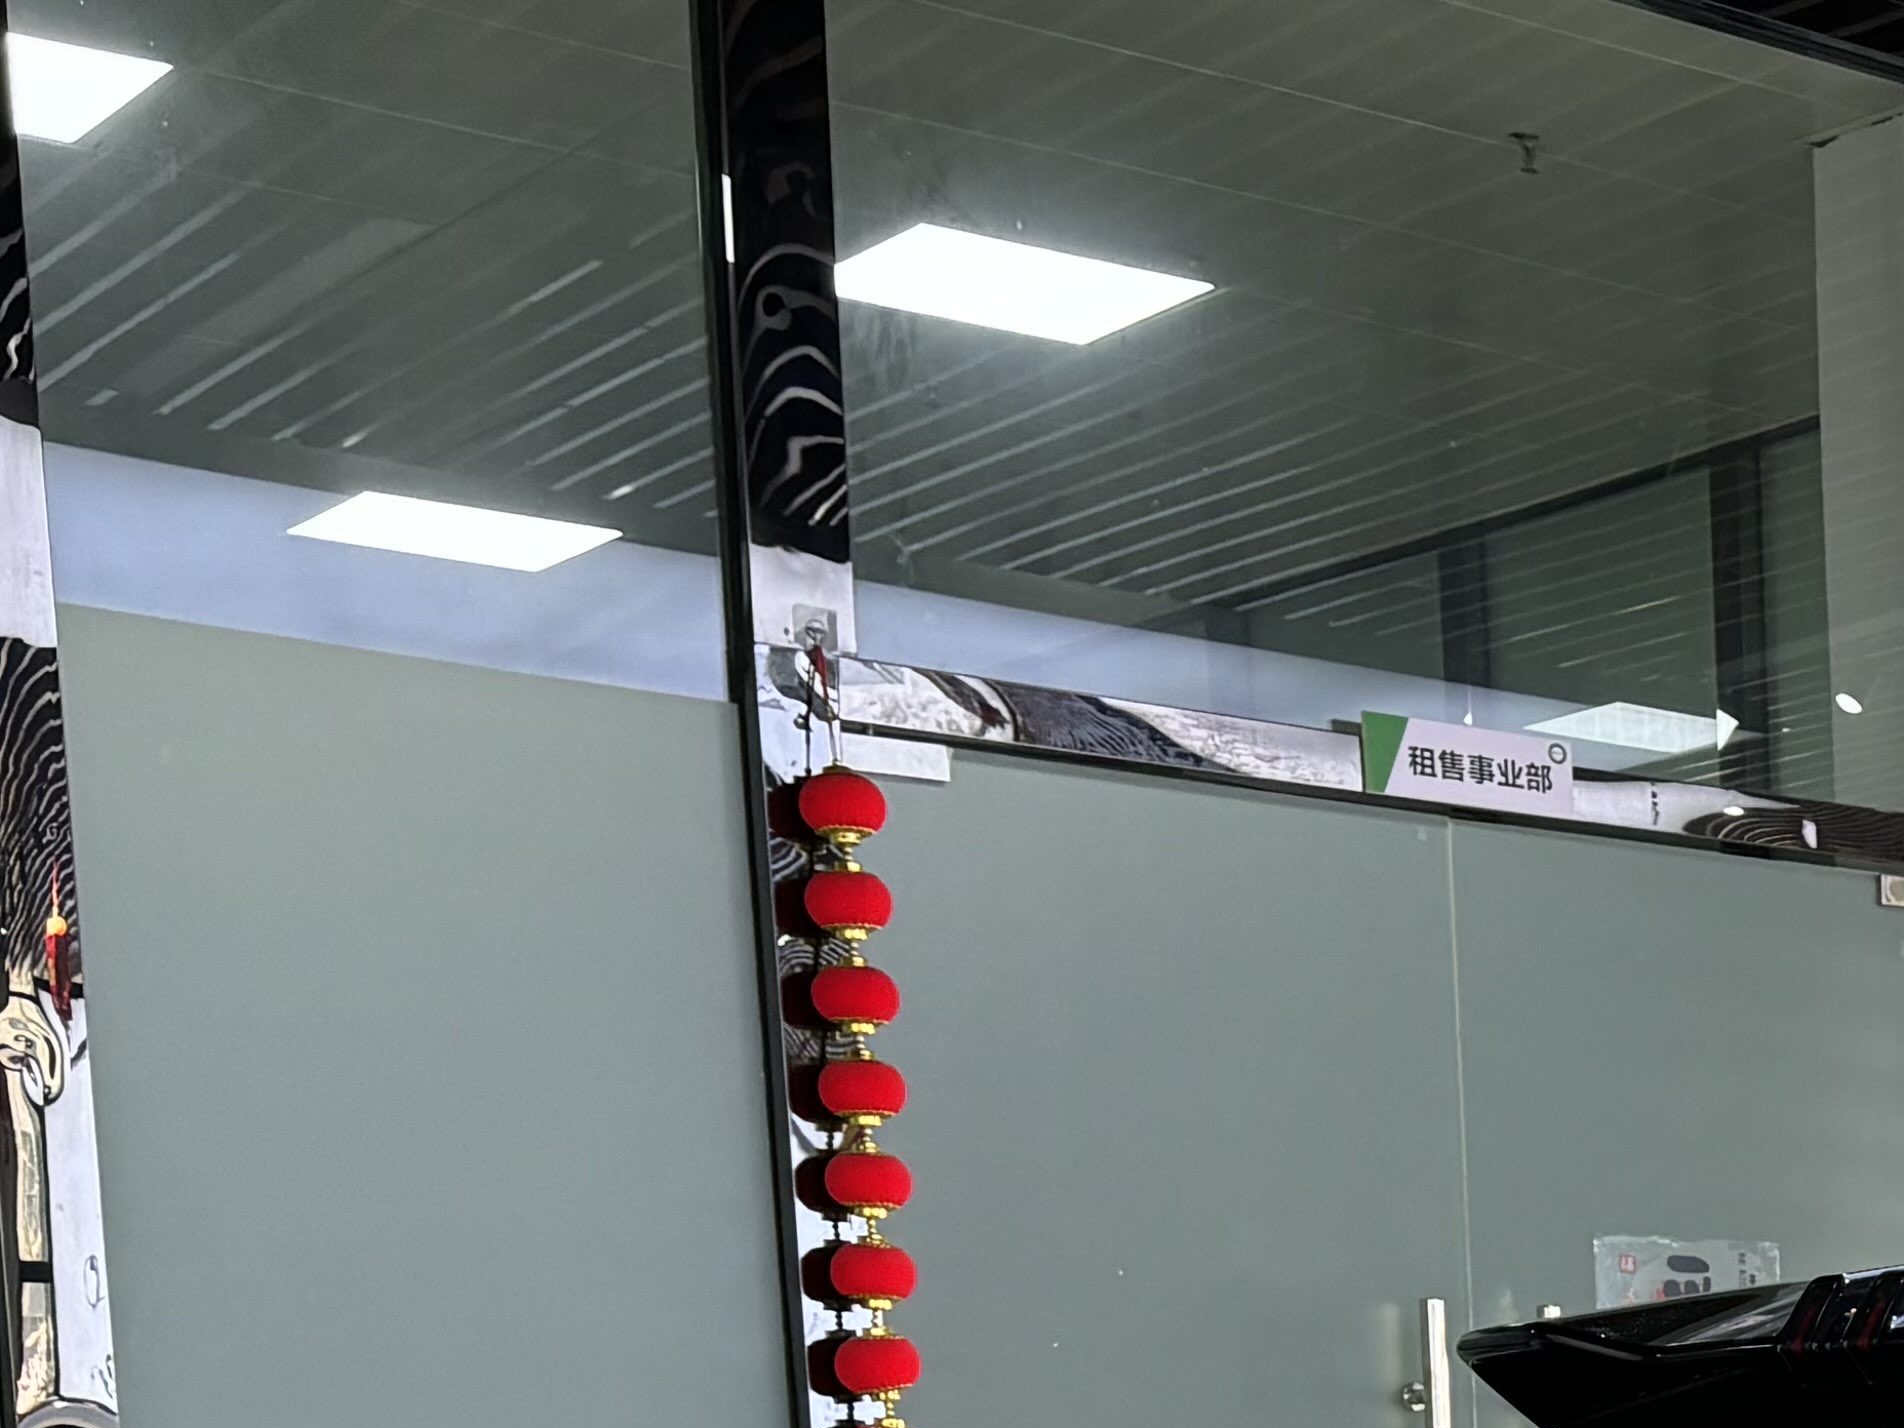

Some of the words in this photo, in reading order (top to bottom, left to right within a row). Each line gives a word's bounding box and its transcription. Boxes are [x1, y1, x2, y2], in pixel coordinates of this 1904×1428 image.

[1408, 746, 1553, 793] 租售事业部
